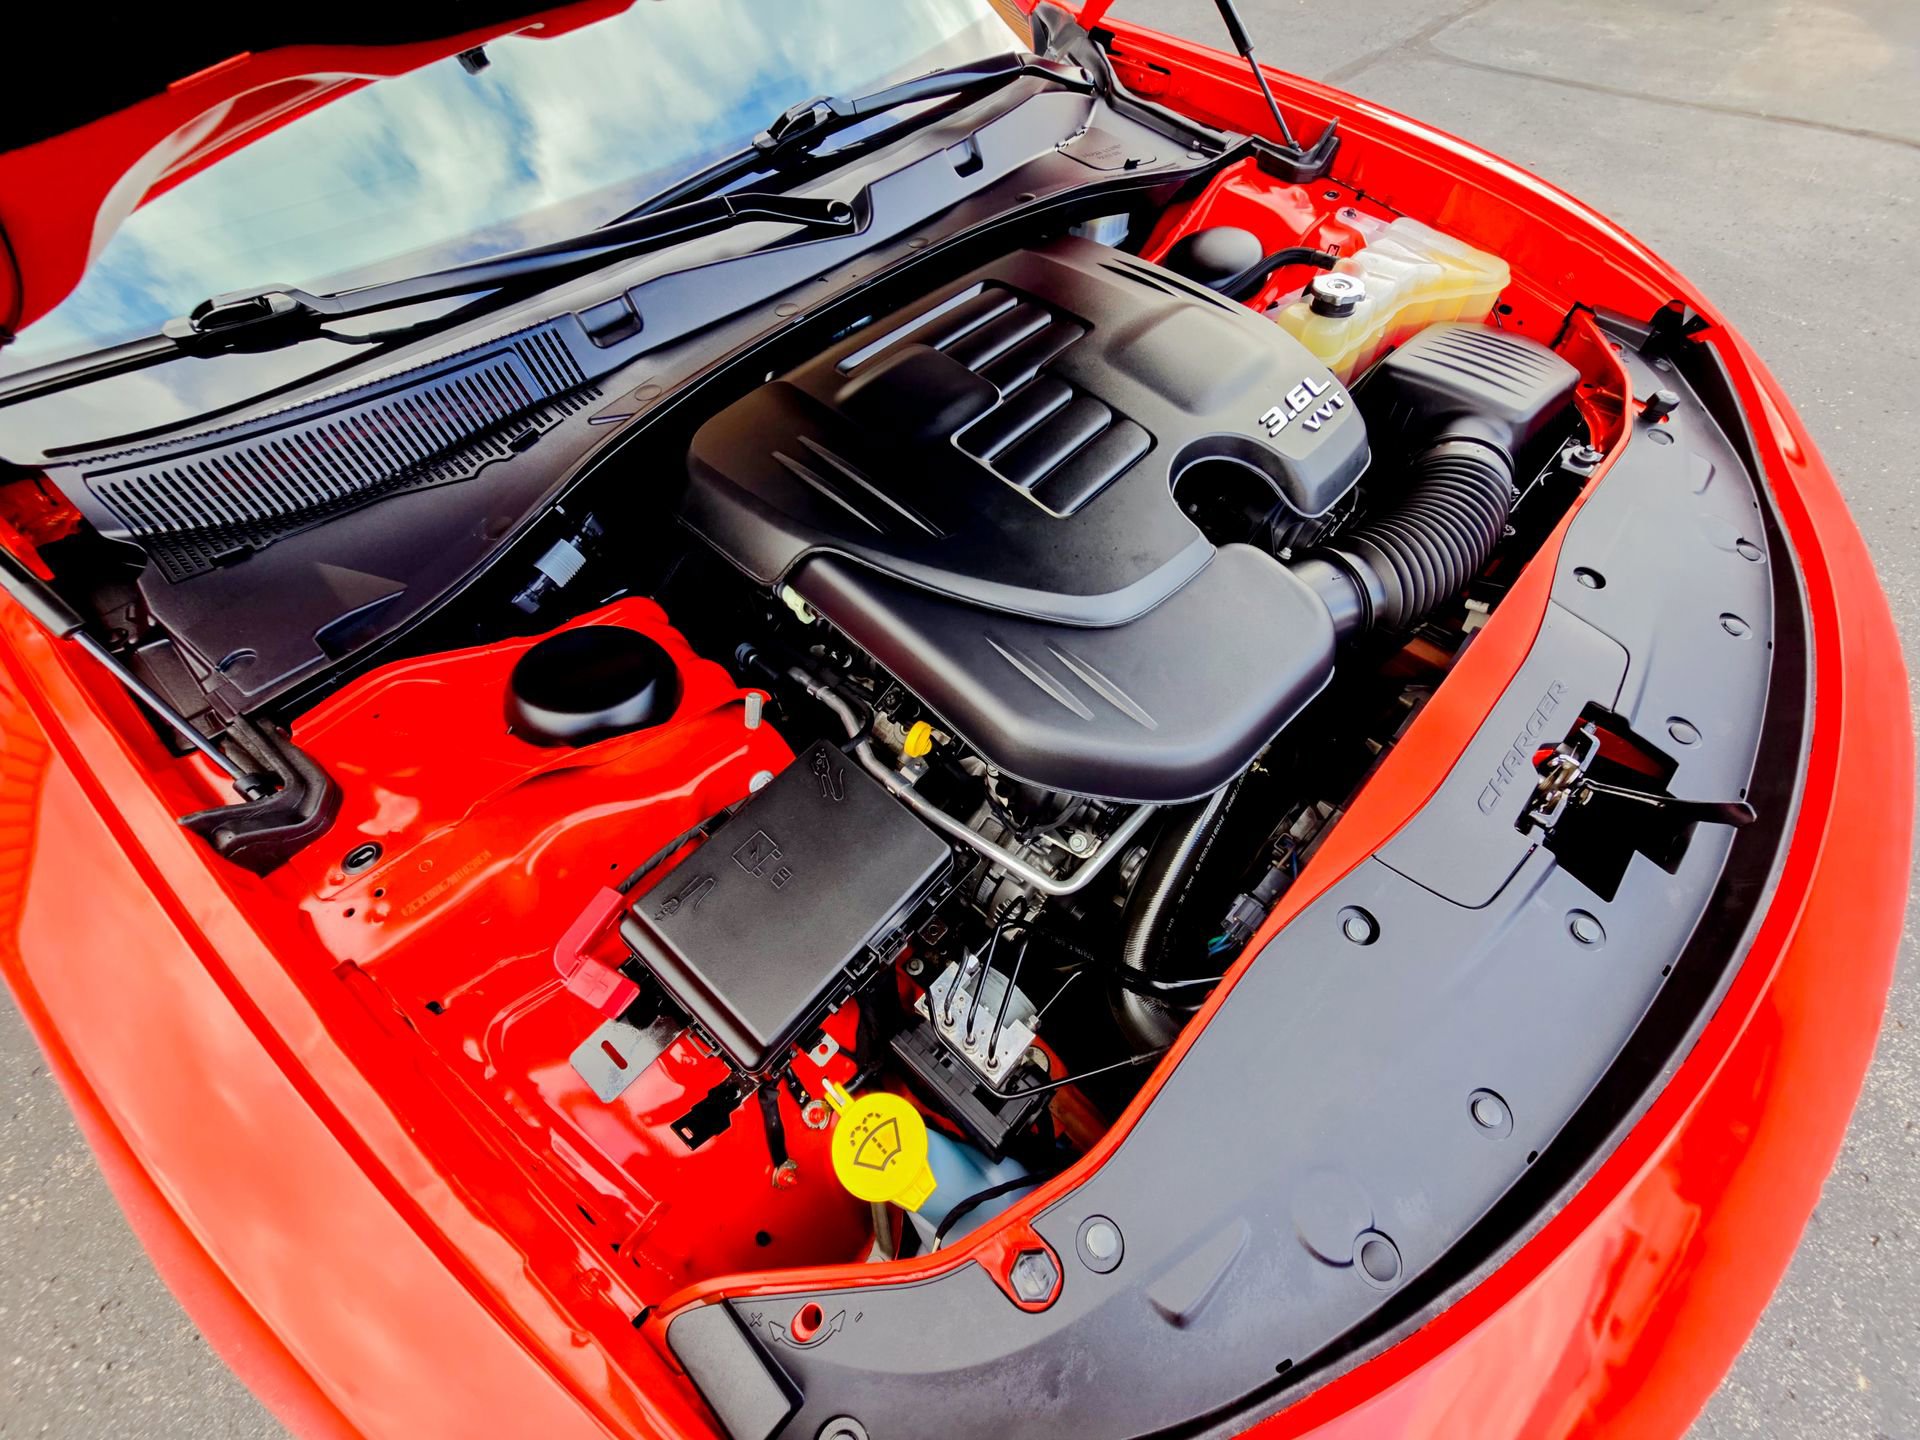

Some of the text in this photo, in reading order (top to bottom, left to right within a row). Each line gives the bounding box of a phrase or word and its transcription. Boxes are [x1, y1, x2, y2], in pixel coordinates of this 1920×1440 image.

[1259, 377, 1331, 437] 3.6L
[1303, 391, 1345, 432] VVT
[1478, 680, 1569, 816] CHARGER
